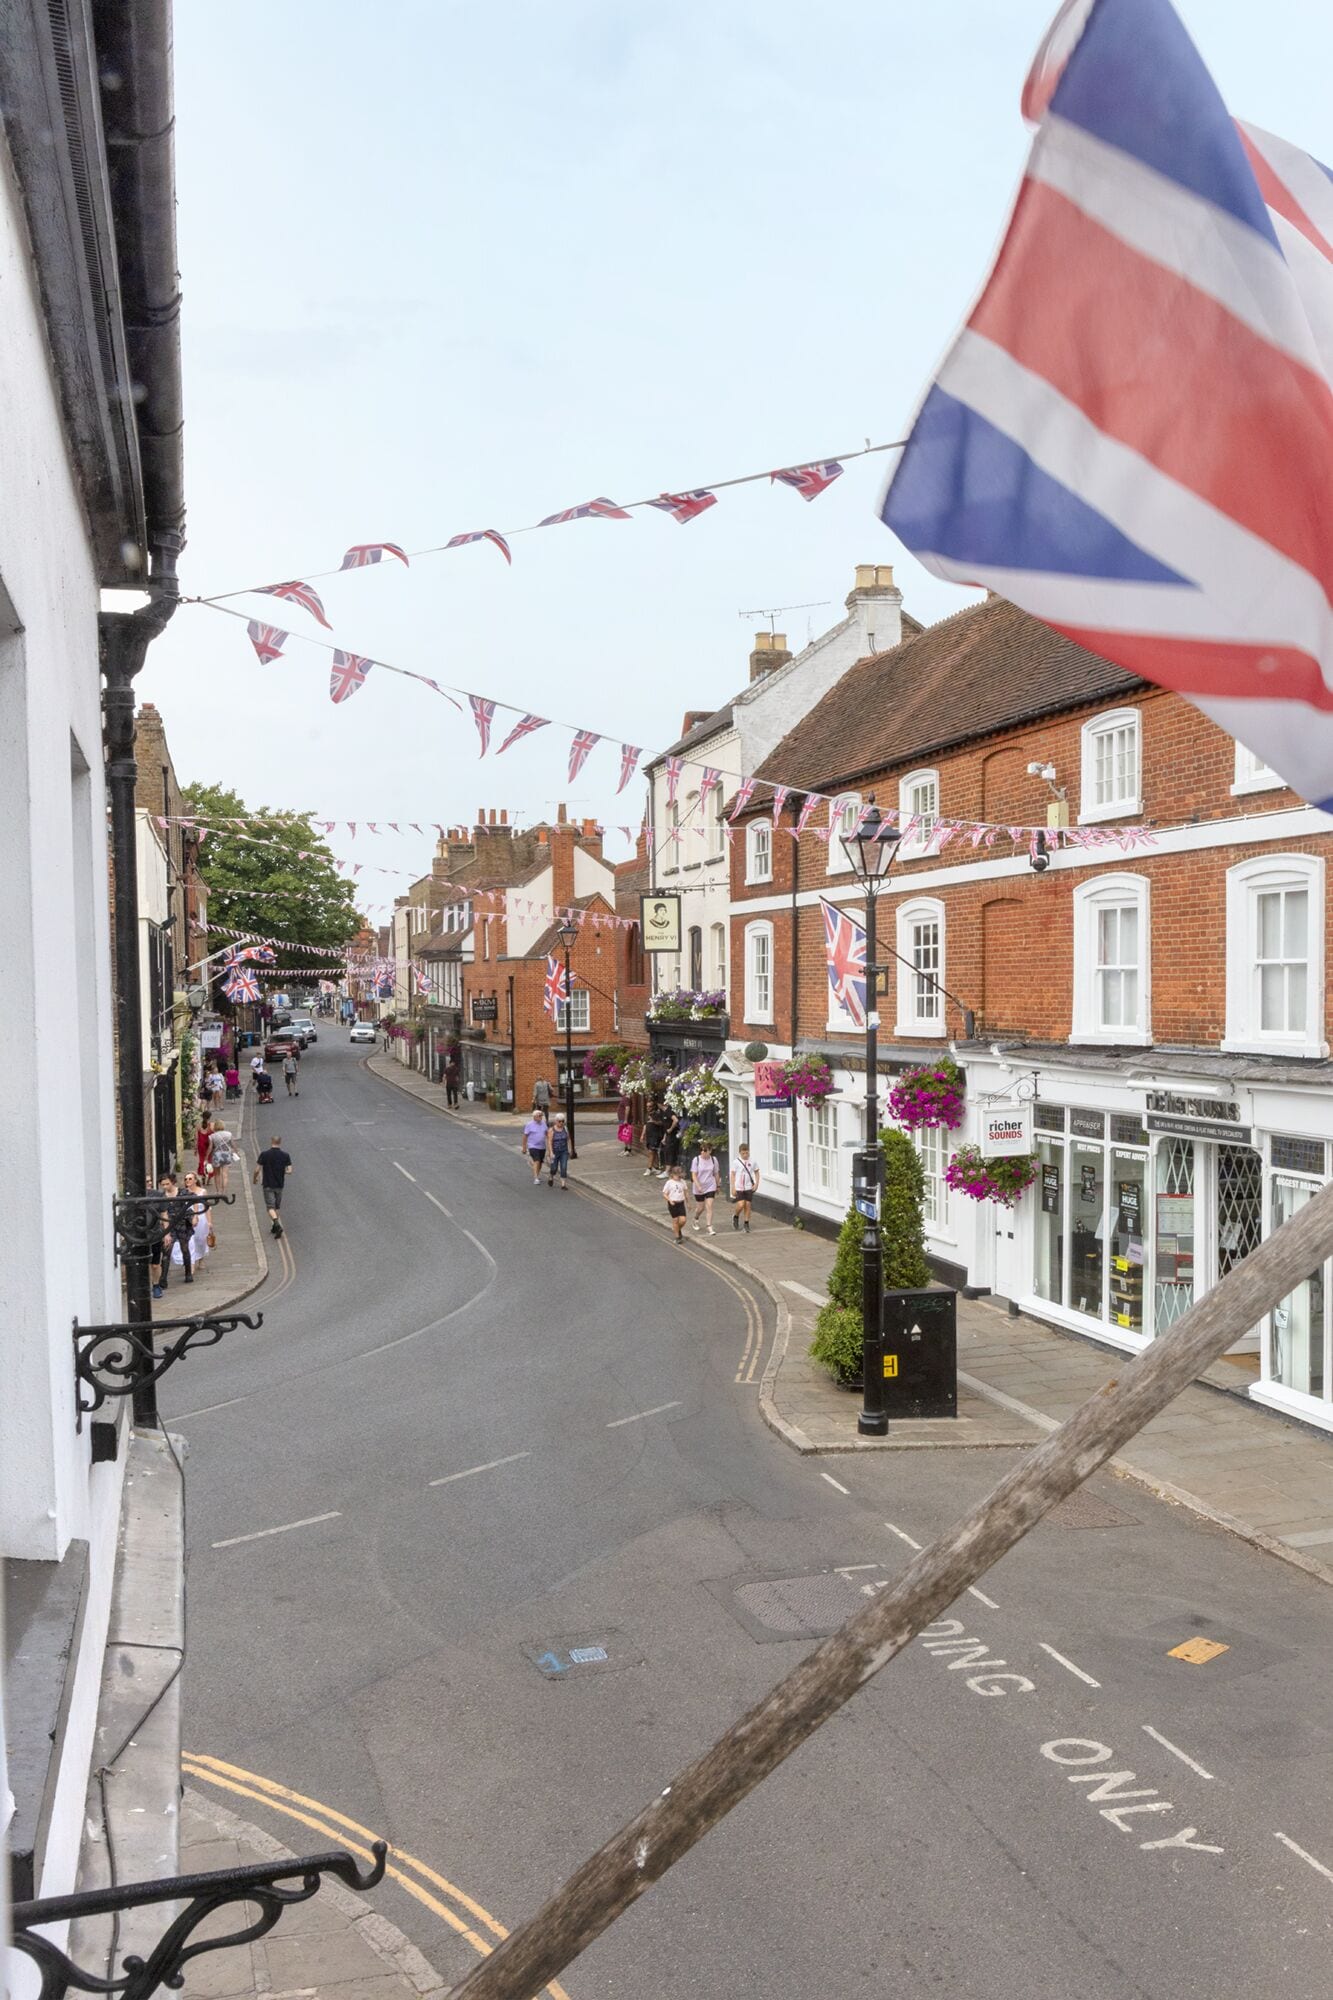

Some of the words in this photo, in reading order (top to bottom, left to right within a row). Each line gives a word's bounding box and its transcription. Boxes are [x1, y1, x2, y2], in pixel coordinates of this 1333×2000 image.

[683, 1038, 697, 1048] HENRY
[989, 1120, 1023, 1131] richer
[988, 1130, 1023, 1140] SOUNDS
[1115, 1150, 1131, 1158] EXPERT
[1132, 1153, 1147, 1161] ADVICE
[1044, 1177, 1057, 1187] HUGE
[1276, 1177, 1298, 1189] BIGGEST
[1121, 1195, 1137, 1206] HUGE
[1040, 1737, 1225, 1853] ONLY
